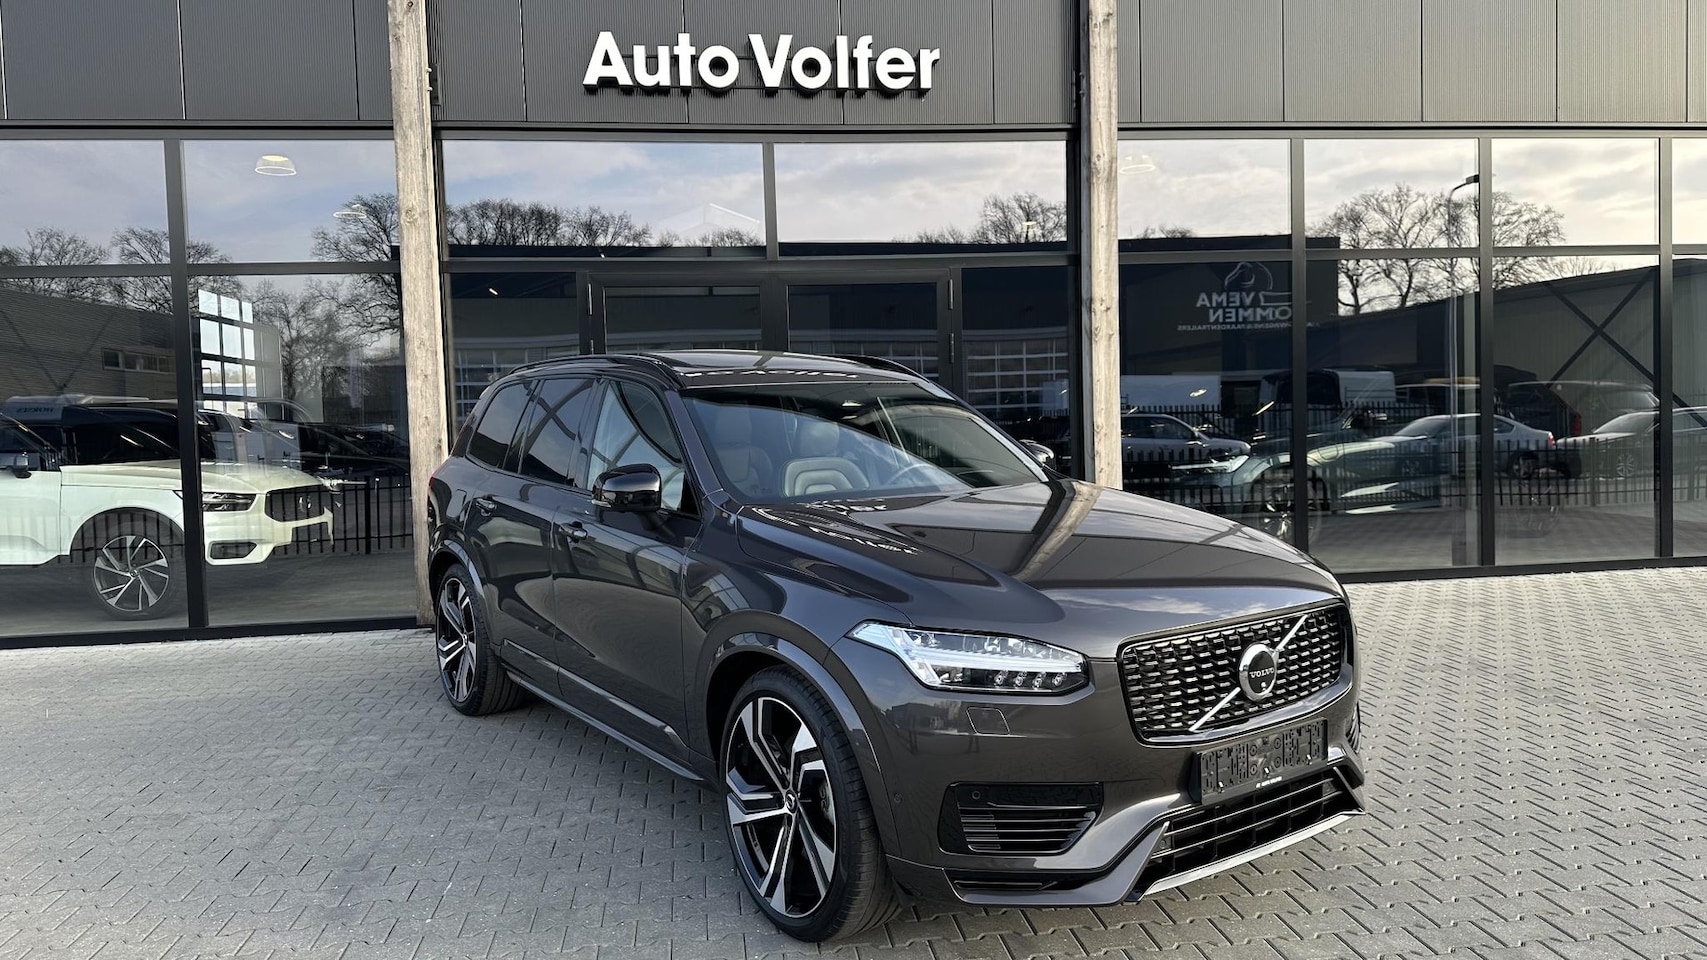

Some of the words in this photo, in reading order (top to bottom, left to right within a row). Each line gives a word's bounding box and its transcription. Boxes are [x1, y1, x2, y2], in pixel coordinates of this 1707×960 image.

[583, 31, 740, 88] Auto
[748, 33, 940, 91] Volfer
[1249, 667, 1275, 679] VOLVO
